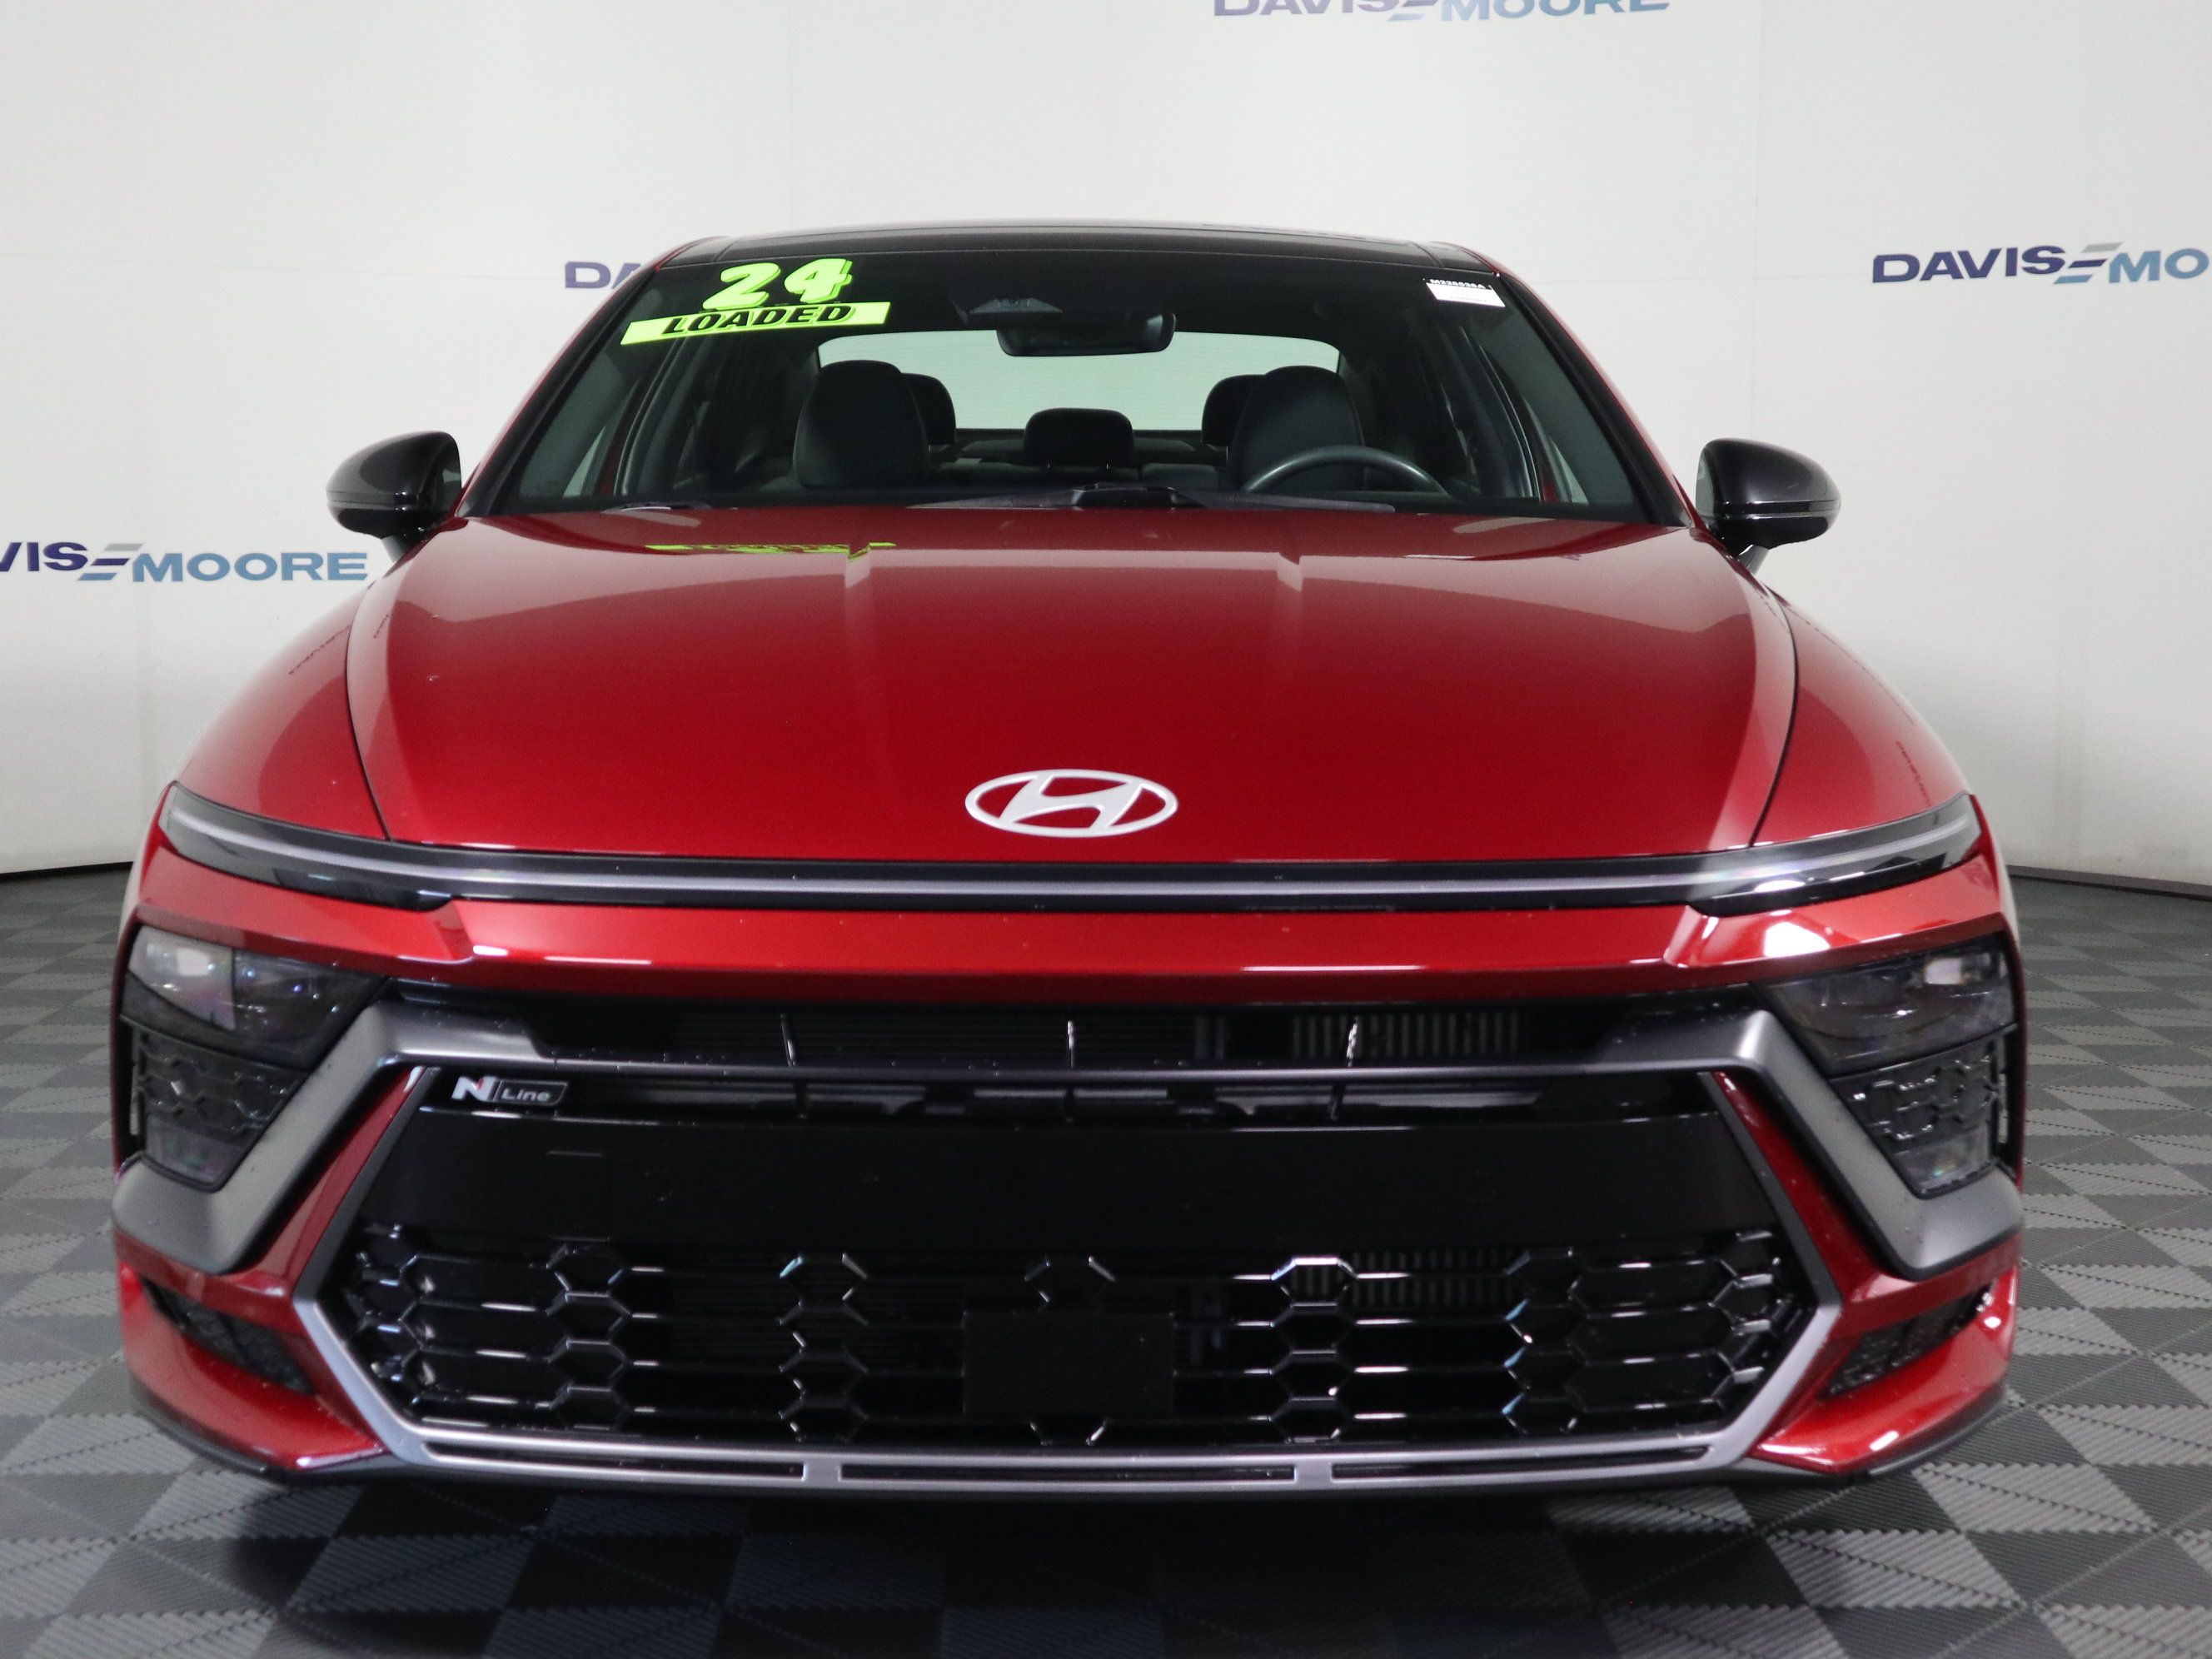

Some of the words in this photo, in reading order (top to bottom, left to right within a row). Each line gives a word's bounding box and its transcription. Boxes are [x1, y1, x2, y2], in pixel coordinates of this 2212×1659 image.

[1872, 245, 2066, 283] DAVIS
[2108, 248, 2210, 283] MO
[702, 258, 853, 311] 24
[661, 305, 855, 335] LOADED
[132, 552, 368, 582] MOORE
[451, 1076, 497, 1102] N
[501, 1088, 551, 1103] Line
